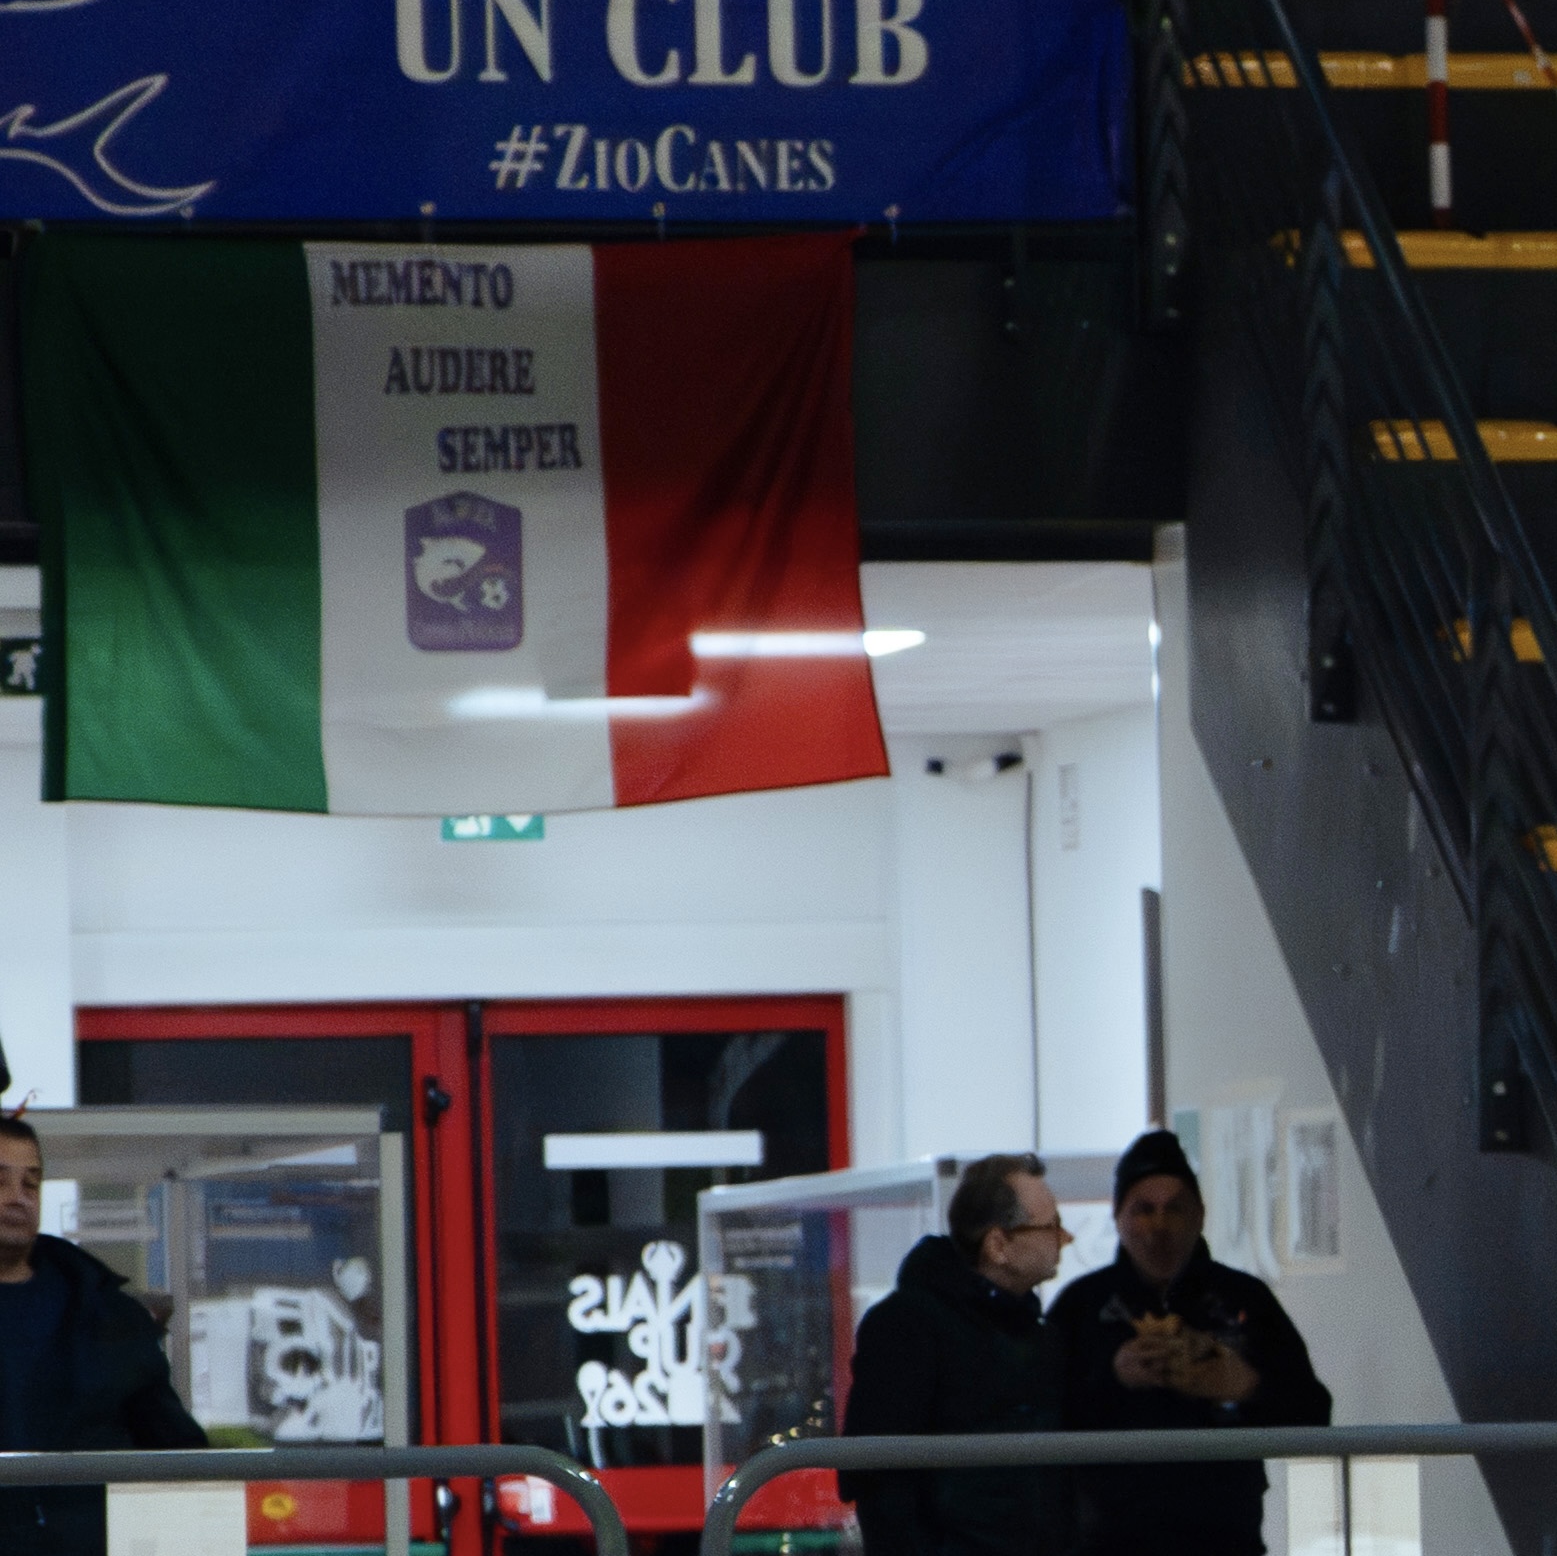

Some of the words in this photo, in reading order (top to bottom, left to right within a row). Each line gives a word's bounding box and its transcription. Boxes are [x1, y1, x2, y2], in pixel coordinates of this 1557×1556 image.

[329, 258, 514, 311] MEMENTO
[384, 346, 537, 395] AUDERE
[437, 422, 583, 474] SEMPER
